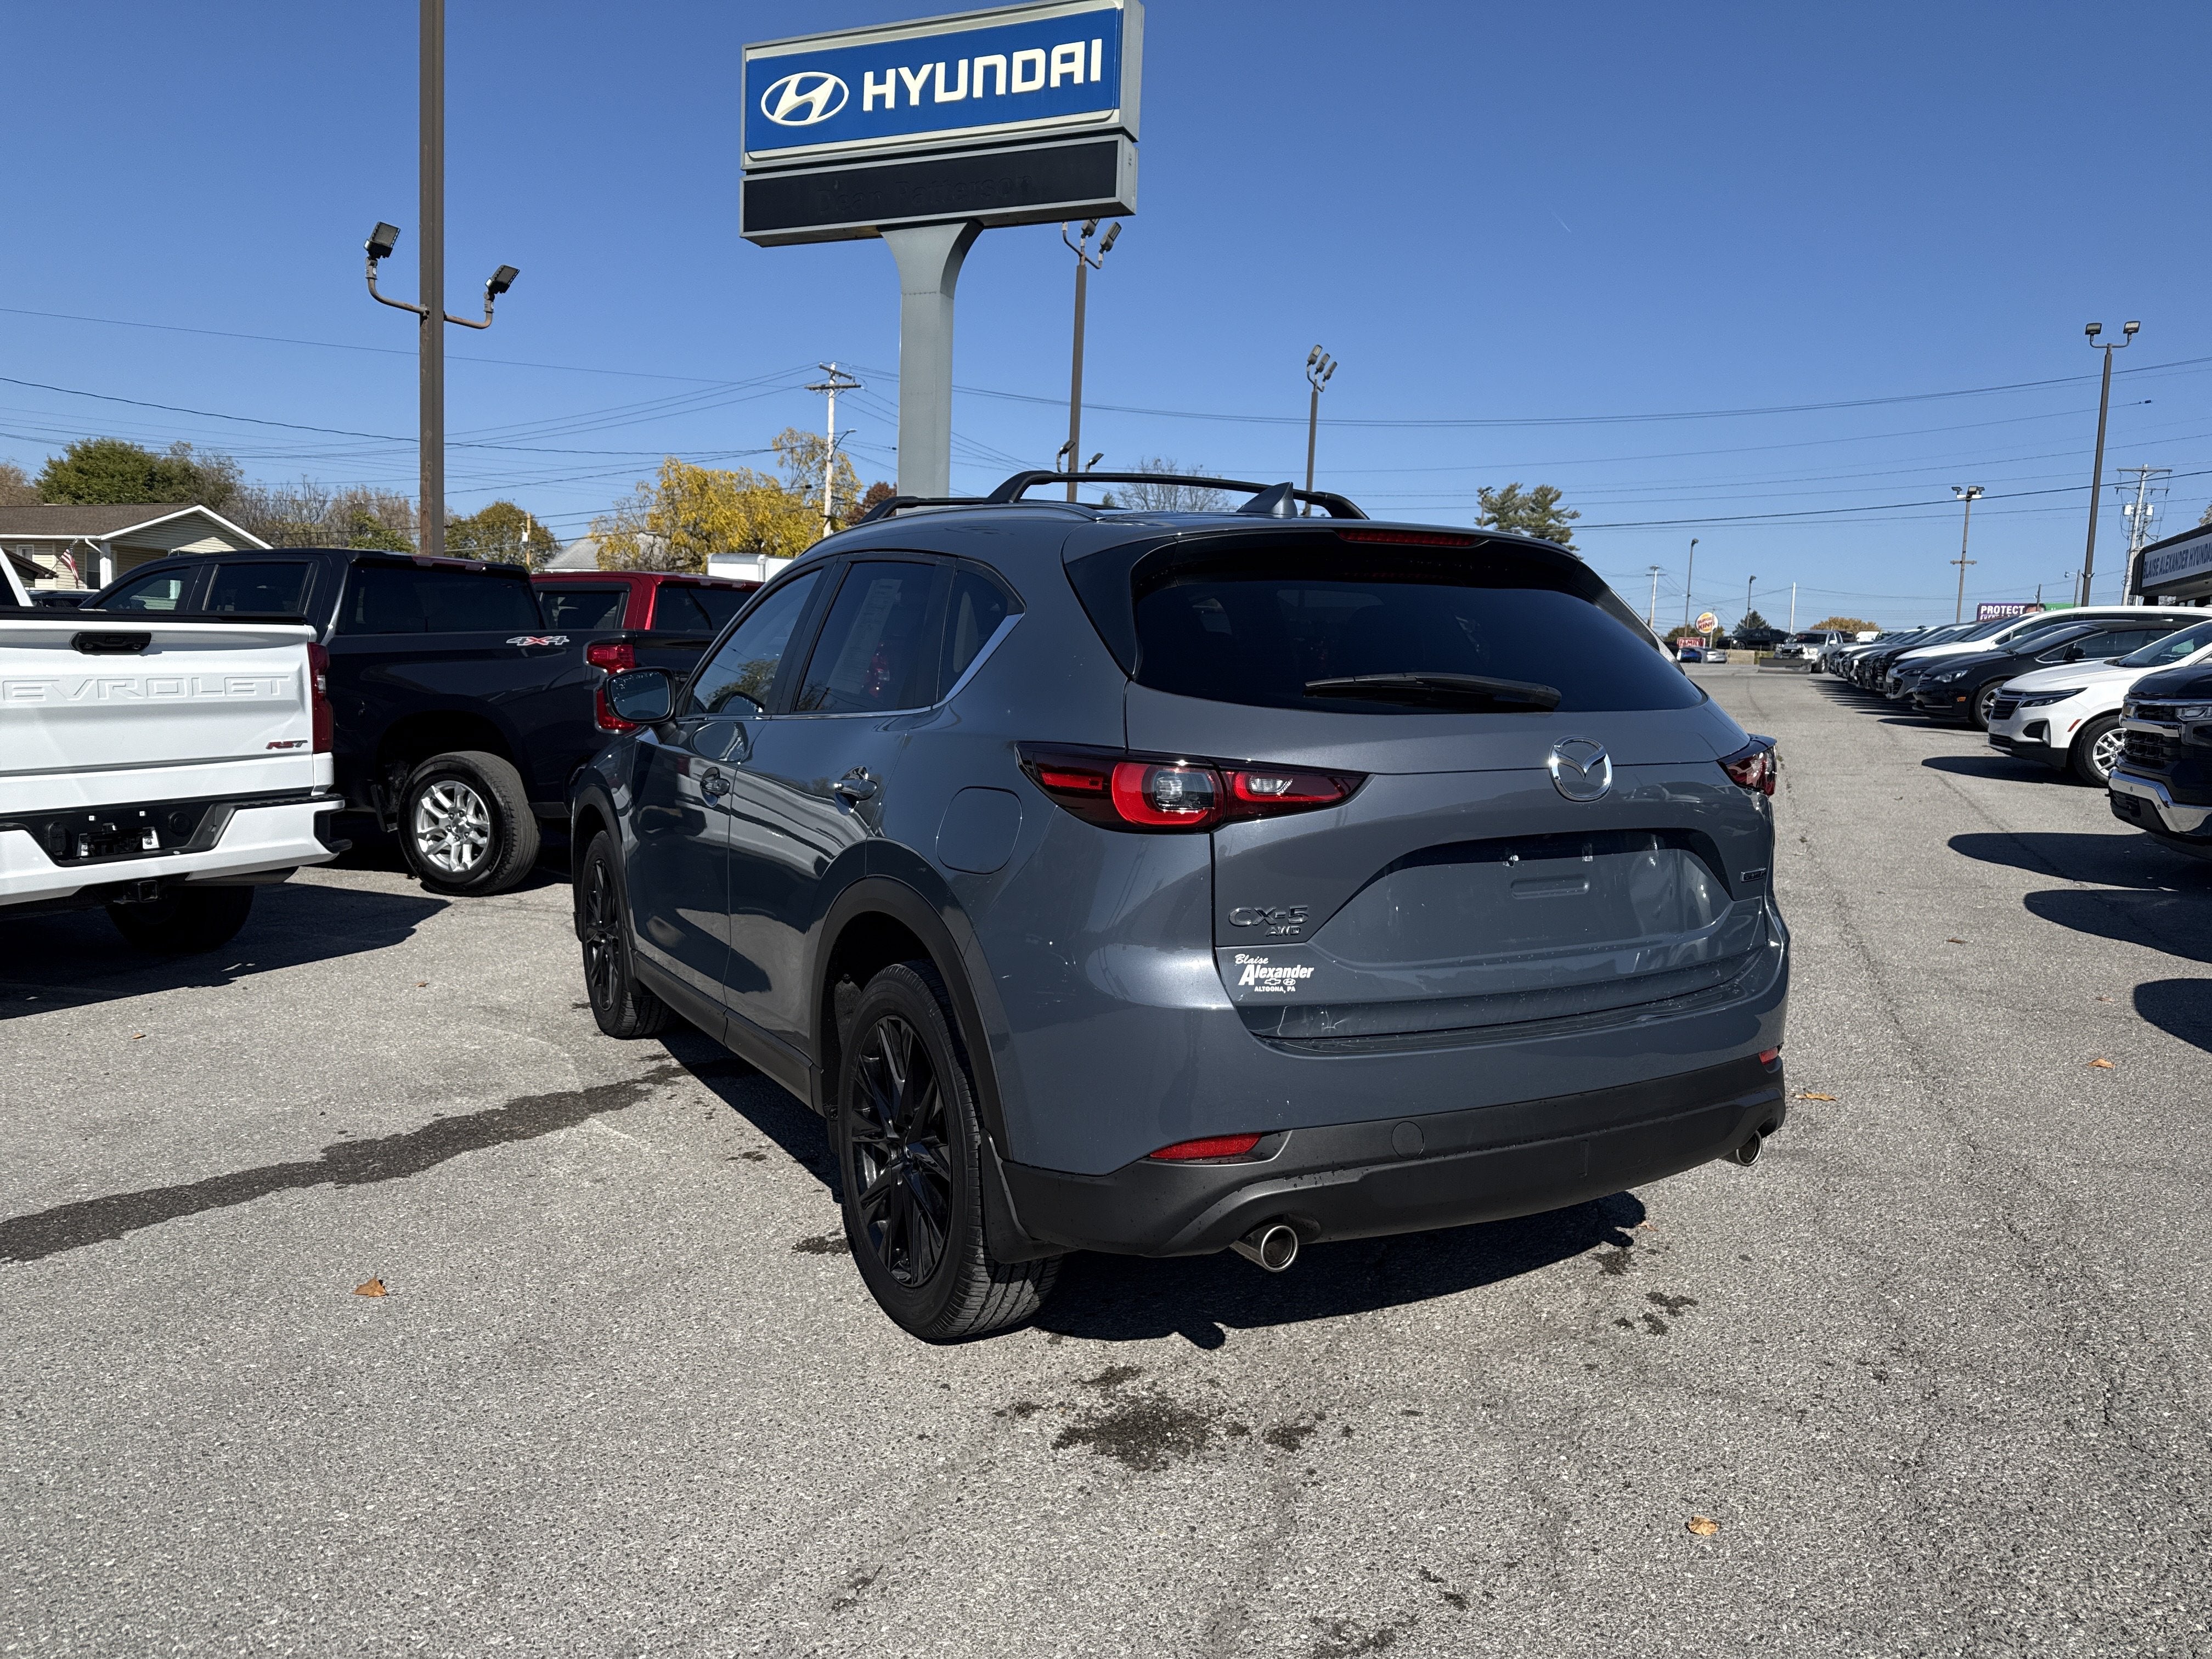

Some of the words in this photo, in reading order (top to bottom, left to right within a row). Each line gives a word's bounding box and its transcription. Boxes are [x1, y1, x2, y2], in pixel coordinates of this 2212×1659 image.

[862, 38, 1102, 112] HYUNDAI
[2159, 549, 2189, 576] ALEXANDER
[2188, 542, 2212, 568] HYUNDA
[1980, 605, 2025, 614] PROTECT
[265, 740, 308, 750] RST
[1228, 905, 1309, 927] CX-5
[1265, 926, 1301, 936] AWD
[1234, 953, 1269, 964] Blaise
[1238, 964, 1314, 986] Alexander
